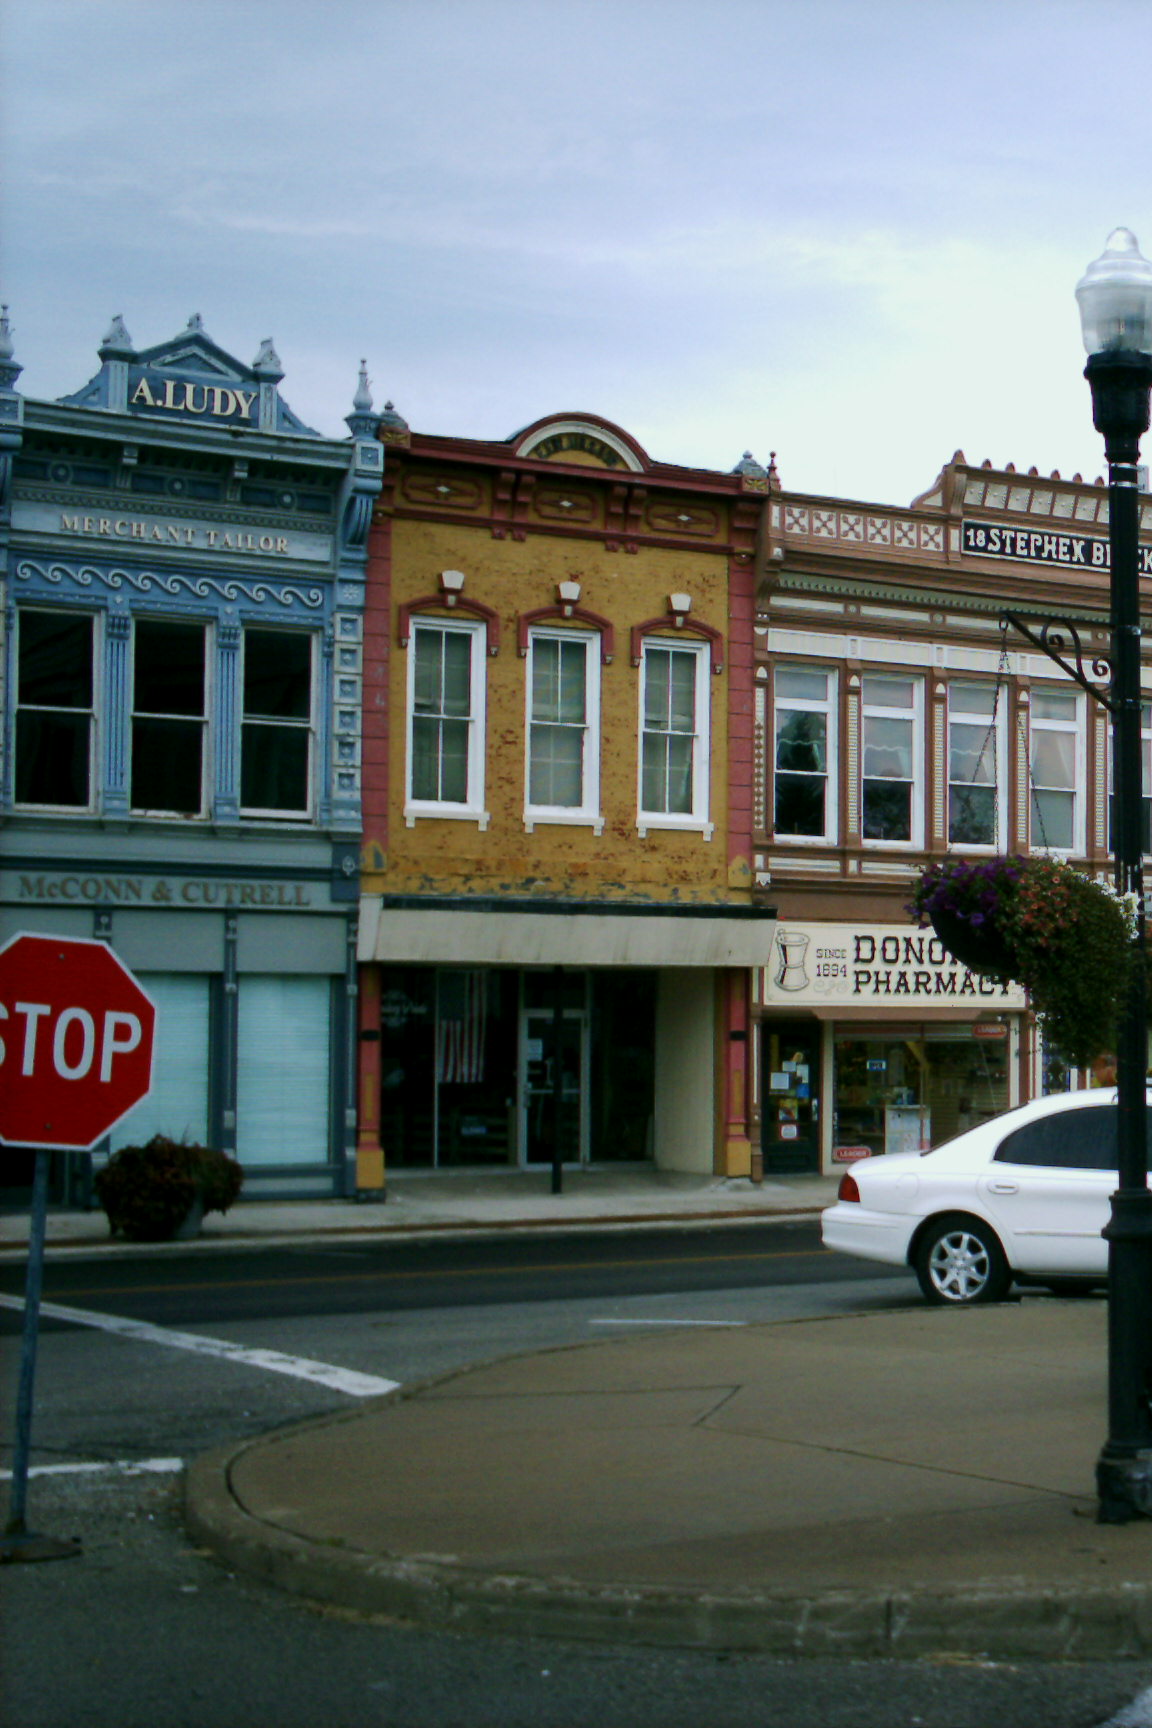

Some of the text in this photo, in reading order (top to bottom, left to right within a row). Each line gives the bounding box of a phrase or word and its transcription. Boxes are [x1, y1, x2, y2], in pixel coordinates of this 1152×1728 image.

[60, 513, 290, 555] MERCHANT TAILOR
[966, 528, 986, 548] 18
[987, 528, 1085, 564] STEPHEN
[18, 875, 312, 907] McCONN & CUTRELL
[853, 934, 958, 966] DONO
[0, 999, 142, 1083] TOP
